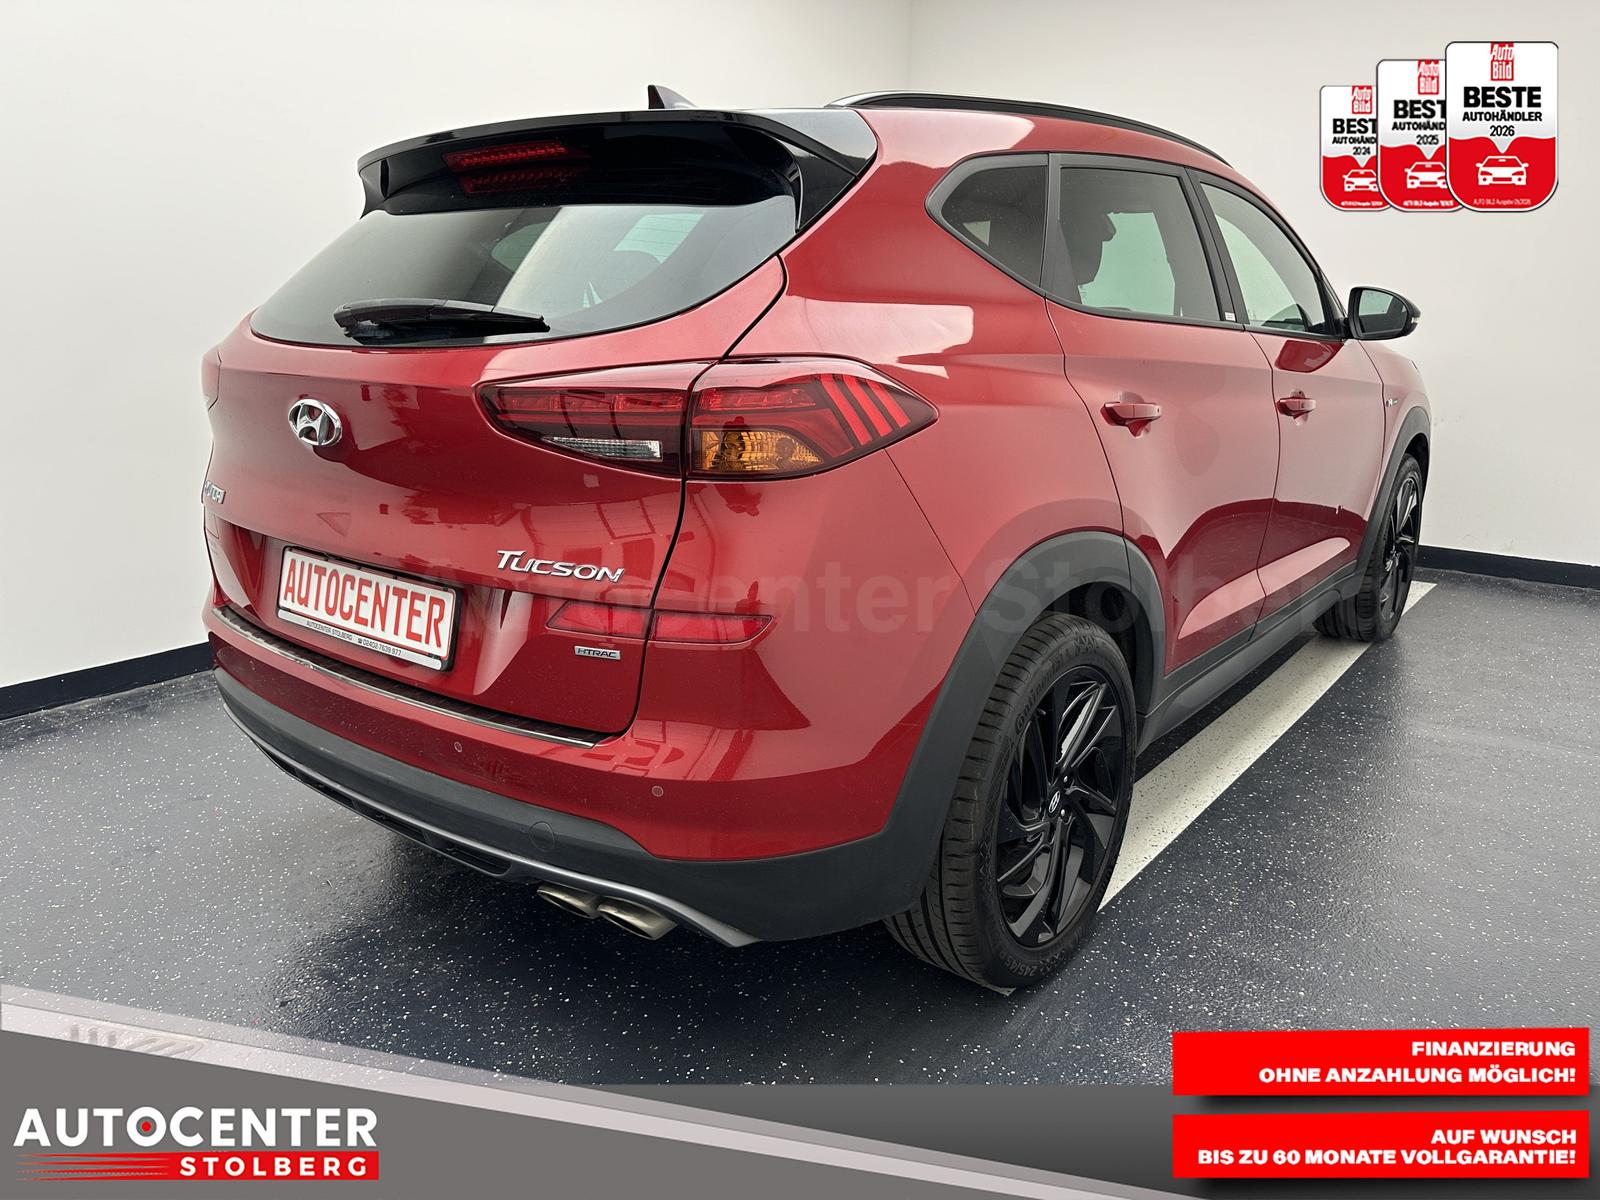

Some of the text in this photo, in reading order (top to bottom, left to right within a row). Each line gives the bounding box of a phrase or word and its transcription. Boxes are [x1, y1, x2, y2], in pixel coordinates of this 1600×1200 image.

[496, 549, 625, 583] TUCSON
[283, 557, 446, 649] AUTOCENTER
[306, 620, 331, 633] AUTOCENTER
[331, 628, 353, 641] STOLBERG
[576, 647, 619, 659] HTRAC
